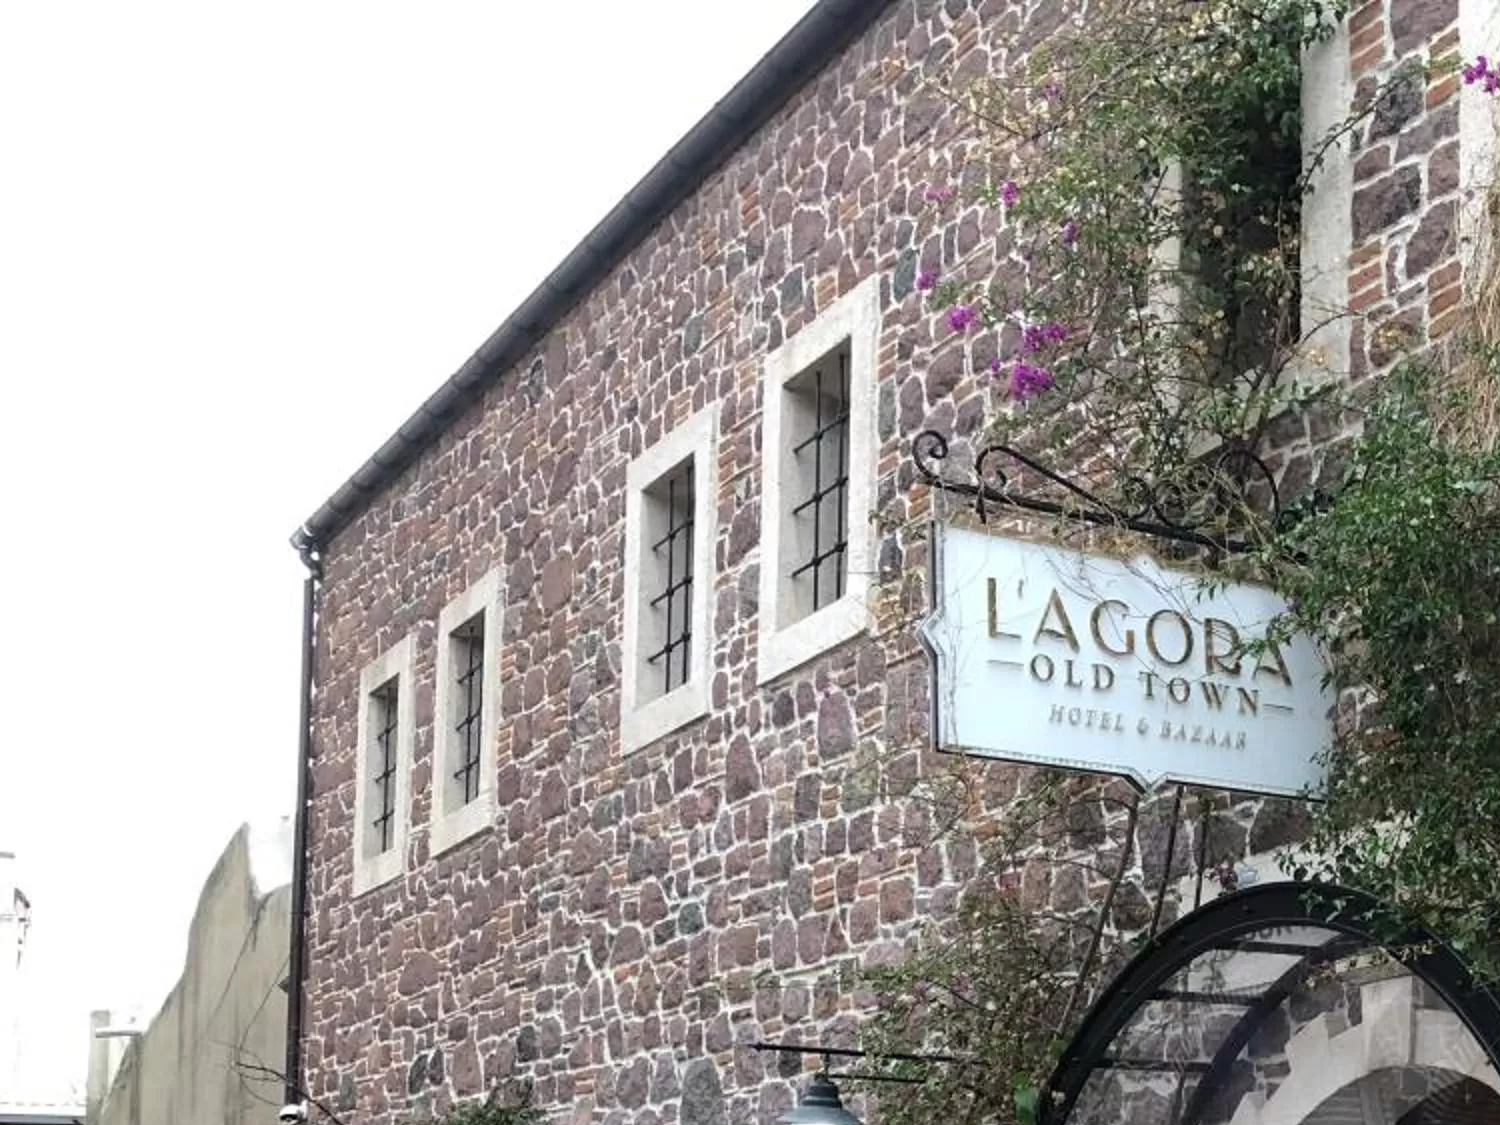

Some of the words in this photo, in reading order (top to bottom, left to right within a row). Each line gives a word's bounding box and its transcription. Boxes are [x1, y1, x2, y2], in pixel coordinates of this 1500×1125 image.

[986, 576, 1293, 688] L'AGORA
[1028, 652, 1116, 692] OLD
[1139, 670, 1260, 717] TOWN
[1048, 703, 1126, 733] HOTEL
[1136, 717, 1150, 736] &
[1159, 719, 1247, 750] BAZAAR
